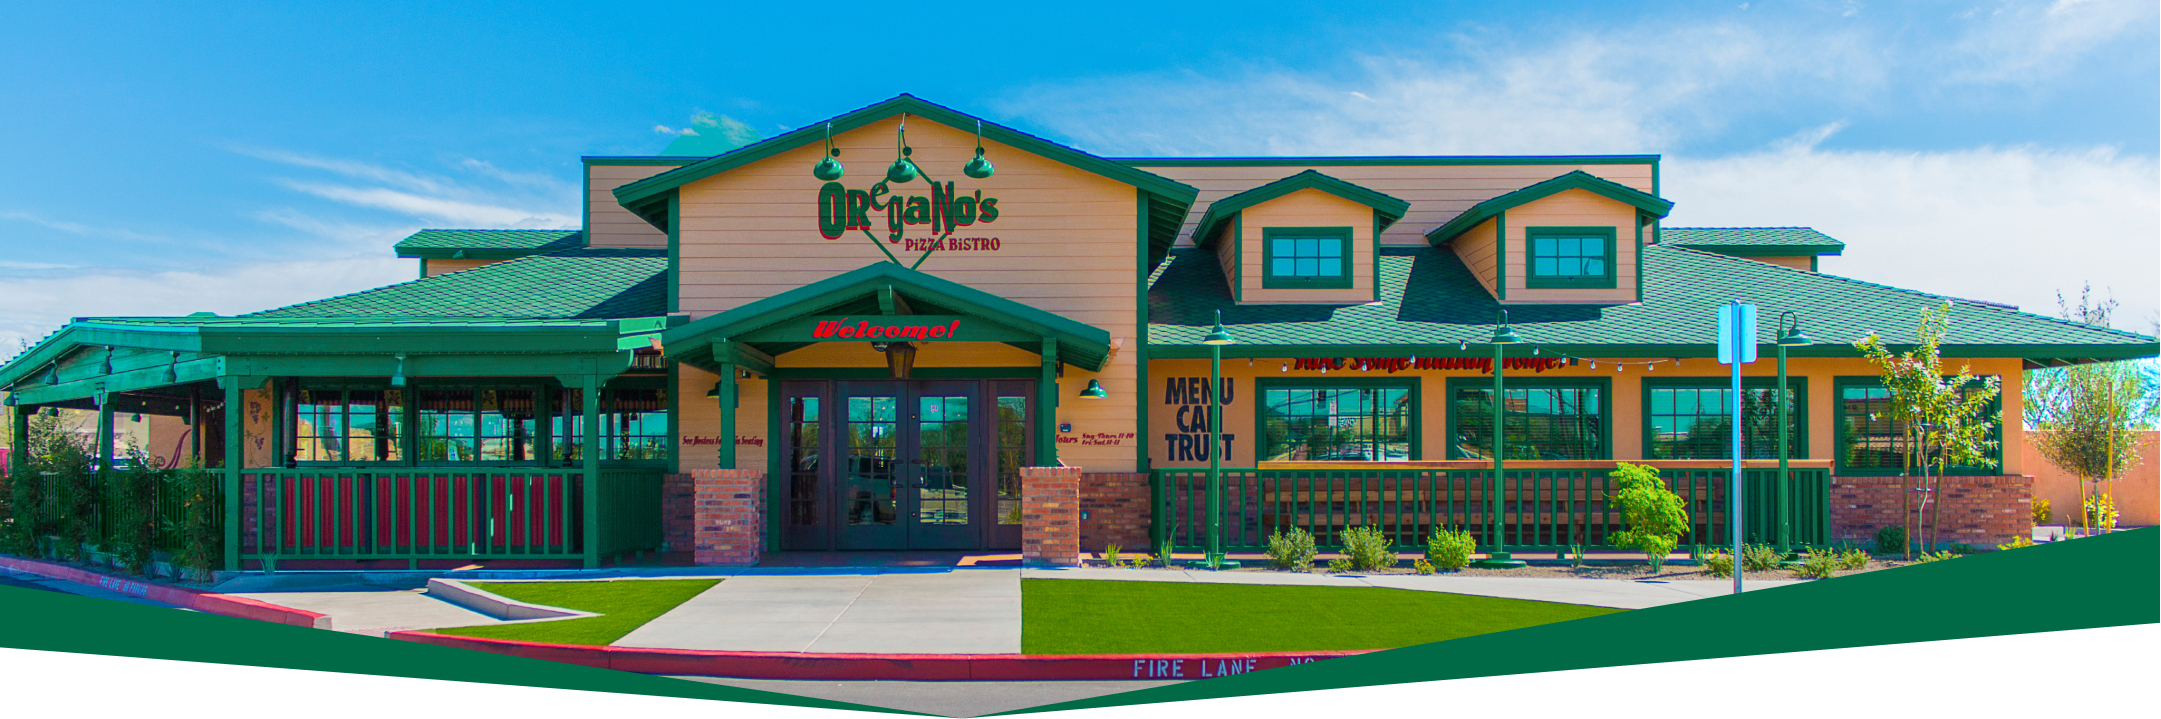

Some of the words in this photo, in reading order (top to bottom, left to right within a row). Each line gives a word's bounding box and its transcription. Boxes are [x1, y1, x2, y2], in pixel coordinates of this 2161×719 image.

[812, 317, 960, 340] Welcome!
[1165, 377, 1234, 405] MENU
[1165, 433, 1235, 461] TRUT
[1133, 659, 1184, 678] FIRE
